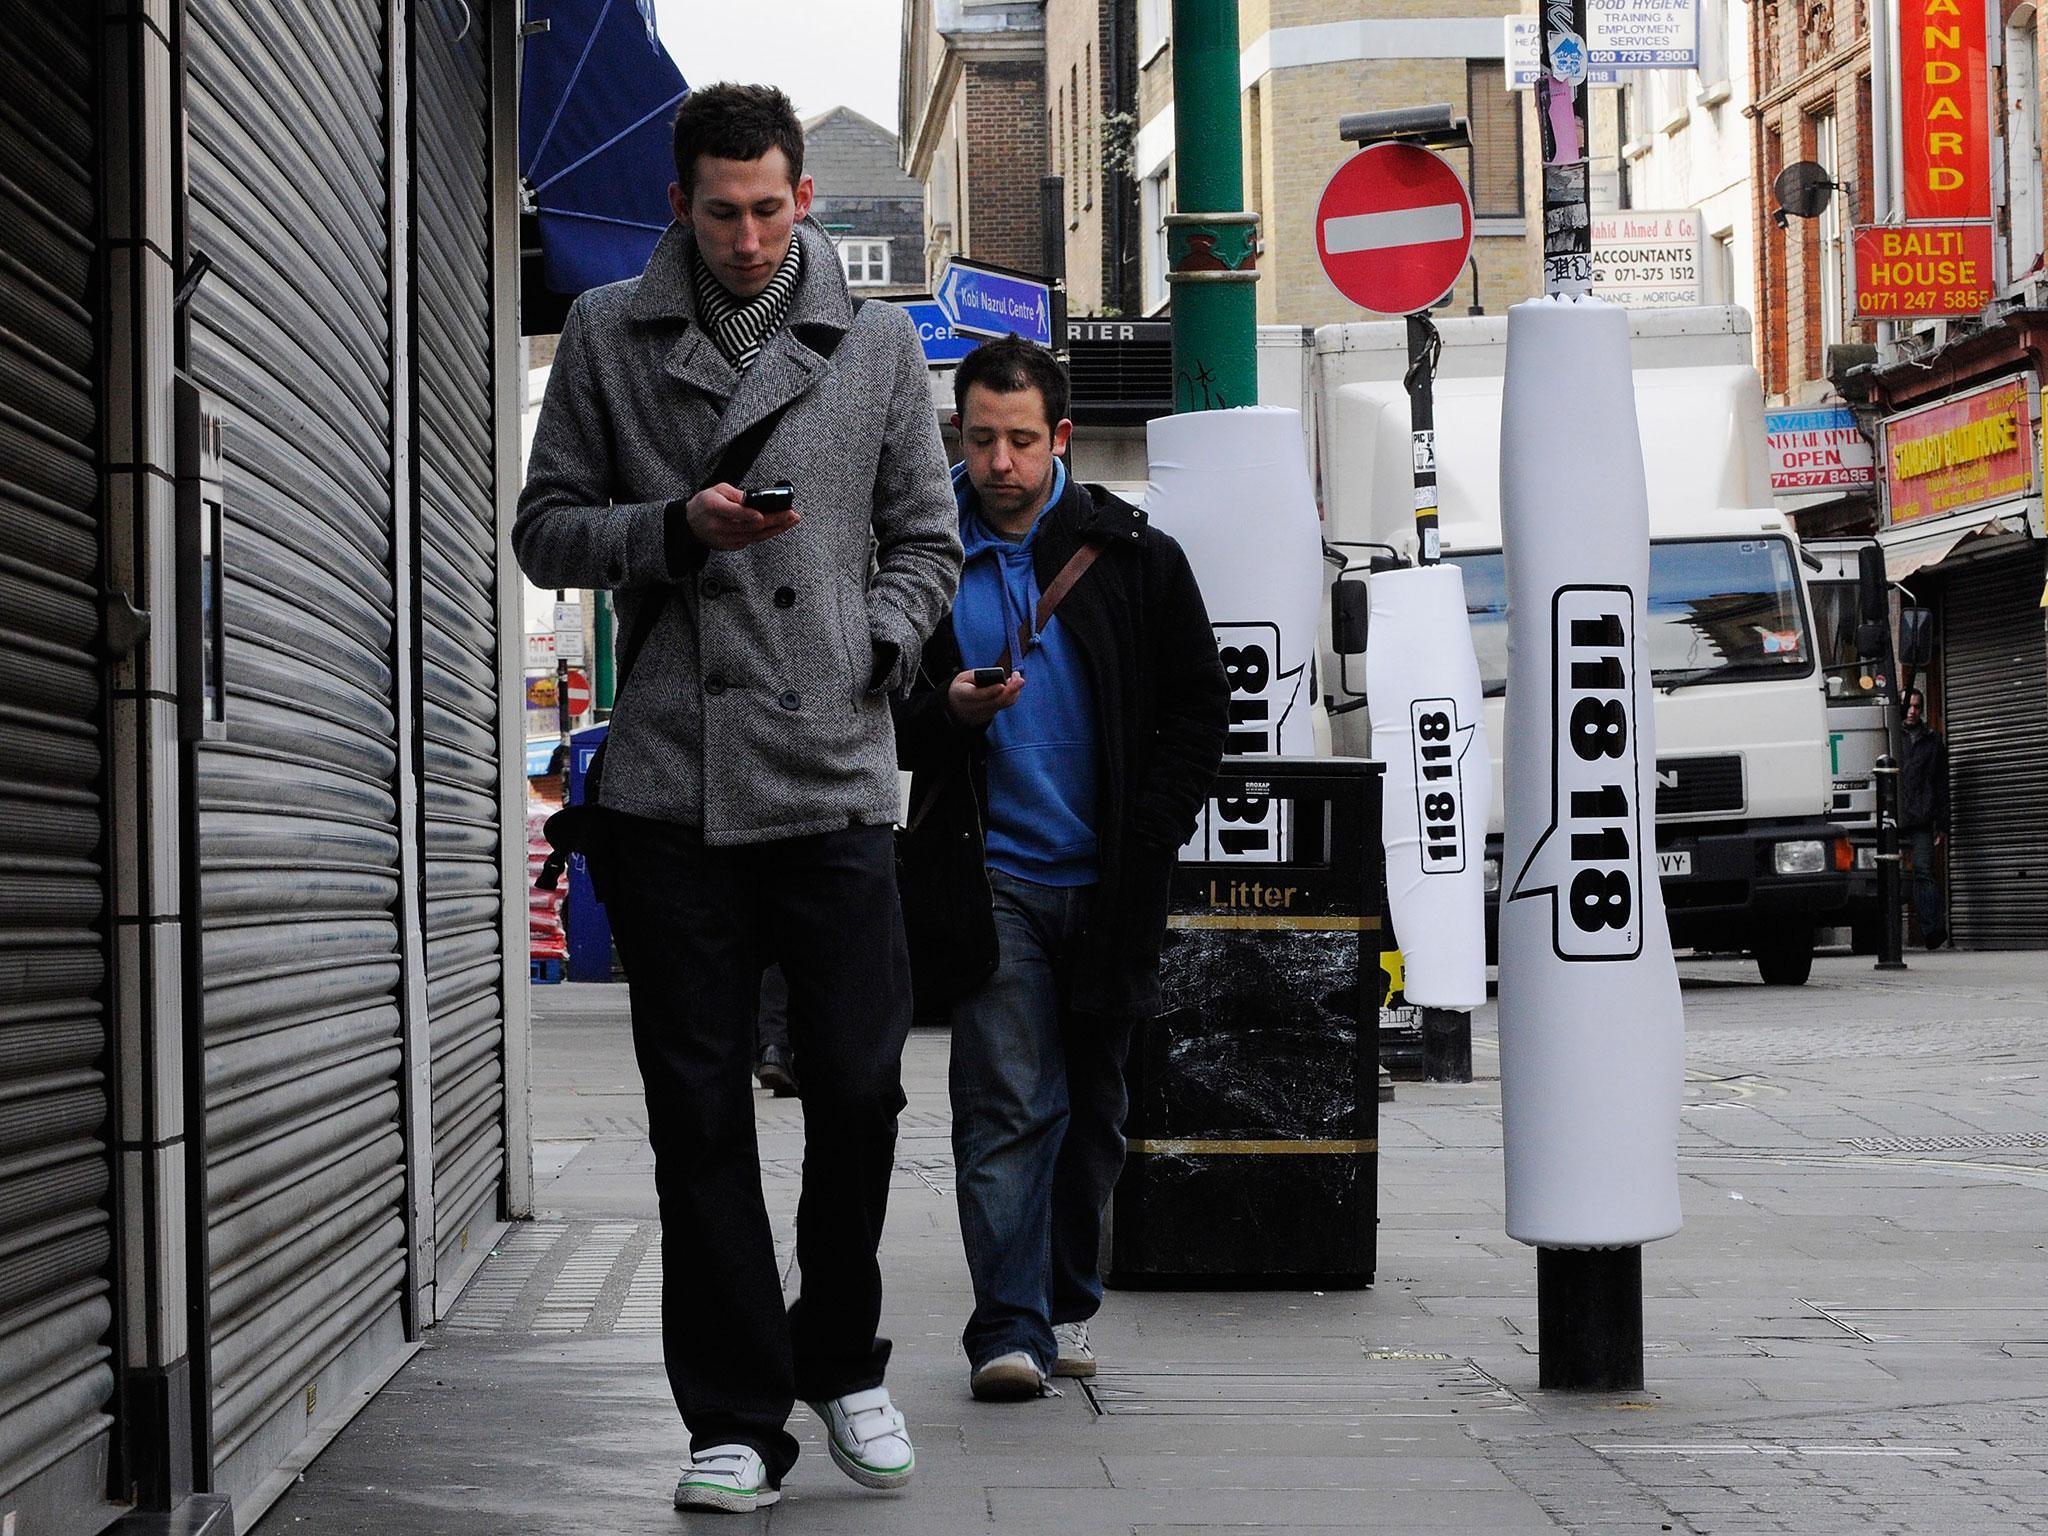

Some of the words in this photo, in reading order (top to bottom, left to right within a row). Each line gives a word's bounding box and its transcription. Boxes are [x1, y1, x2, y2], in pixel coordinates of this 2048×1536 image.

[1588, 0, 1625, 10] FOOD
[1632, 0, 1690, 10] HYGIENE
[1604, 13, 1663, 23] TRAINING
[1667, 13, 1675, 22] &
[1598, 24, 1680, 34] EMPLOYMENT
[1610, 36, 1670, 46] SERVICES
[1590, 51, 1616, 63] 020
[1621, 51, 1652, 62] 7375
[1656, 51, 1689, 62] 2900
[1623, 220, 1658, 238] Ahmed
[1664, 219, 1672, 237] &
[1679, 218, 1695, 237] Co.
[1883, 232, 1964, 257] BALTI
[1593, 248, 1692, 264] ACCOUNTANTS
[1614, 267, 1664, 281] 071-375
[1670, 266, 1695, 280] 1512
[1871, 261, 1977, 286] HOUSE
[961, 288, 979, 307] Kobi
[980, 292, 1007, 315] Nazrul
[1008, 298, 1035, 321] Centre
[1642, 290, 1696, 303] MORTGAGE
[1859, 293, 1898, 311] 0171
[1904, 292, 1937, 310] 247
[1976, 411, 2018, 457] HOUSE
[1783, 450, 1841, 468] OPEN
[1569, 614, 1627, 761] 118
[1418, 711, 1452, 781] 118
[1424, 791, 1457, 861] 118
[1569, 784, 1632, 933] 118
[1658, 854, 1683, 872] VY
[1209, 880, 1297, 908] Litter
